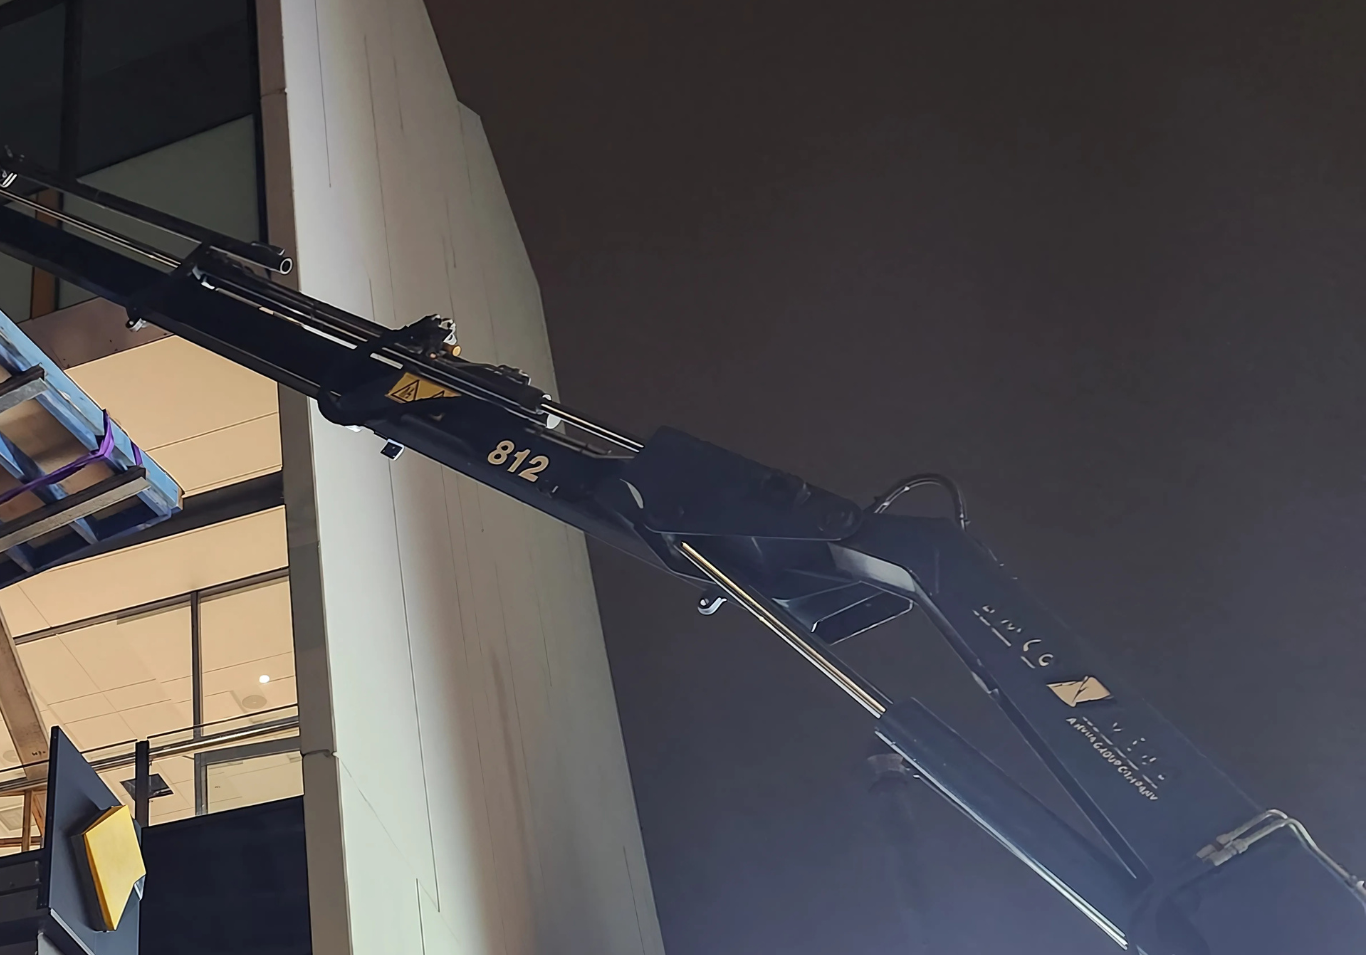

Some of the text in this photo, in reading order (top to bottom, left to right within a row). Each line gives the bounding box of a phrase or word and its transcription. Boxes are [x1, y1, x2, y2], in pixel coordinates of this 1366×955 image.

[486, 438, 551, 484] 812
[1065, 717, 1077, 725] A
[1092, 742, 1123, 766] GROUP
[1117, 765, 1159, 801] COMPANY
